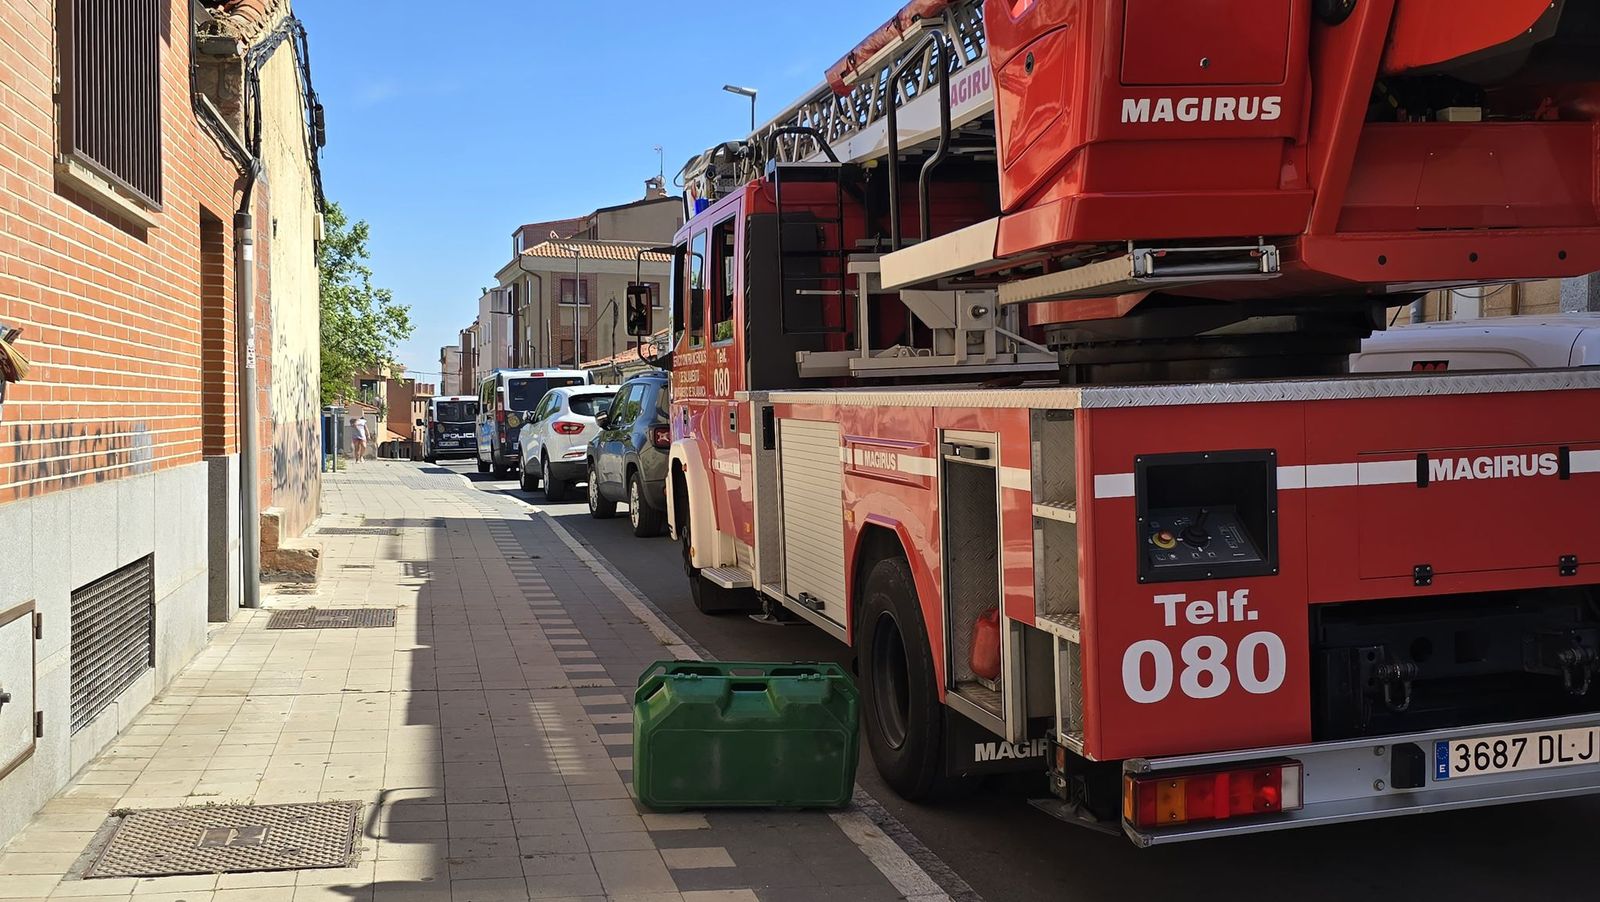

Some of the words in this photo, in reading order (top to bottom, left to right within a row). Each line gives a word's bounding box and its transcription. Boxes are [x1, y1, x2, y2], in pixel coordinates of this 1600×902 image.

[950, 64, 990, 108] AGIRU
[1120, 96, 1282, 124] MAGIRUS
[713, 367, 730, 397] 080
[863, 450, 897, 471] MAGIRUS
[1428, 453, 1559, 482] MAGIRUS
[1153, 588, 1260, 627] Telf.
[1121, 631, 1288, 704] 080
[974, 738, 1049, 762] MAGIR
[1439, 764, 1446, 773] E
[1454, 737, 1528, 773] 3687
